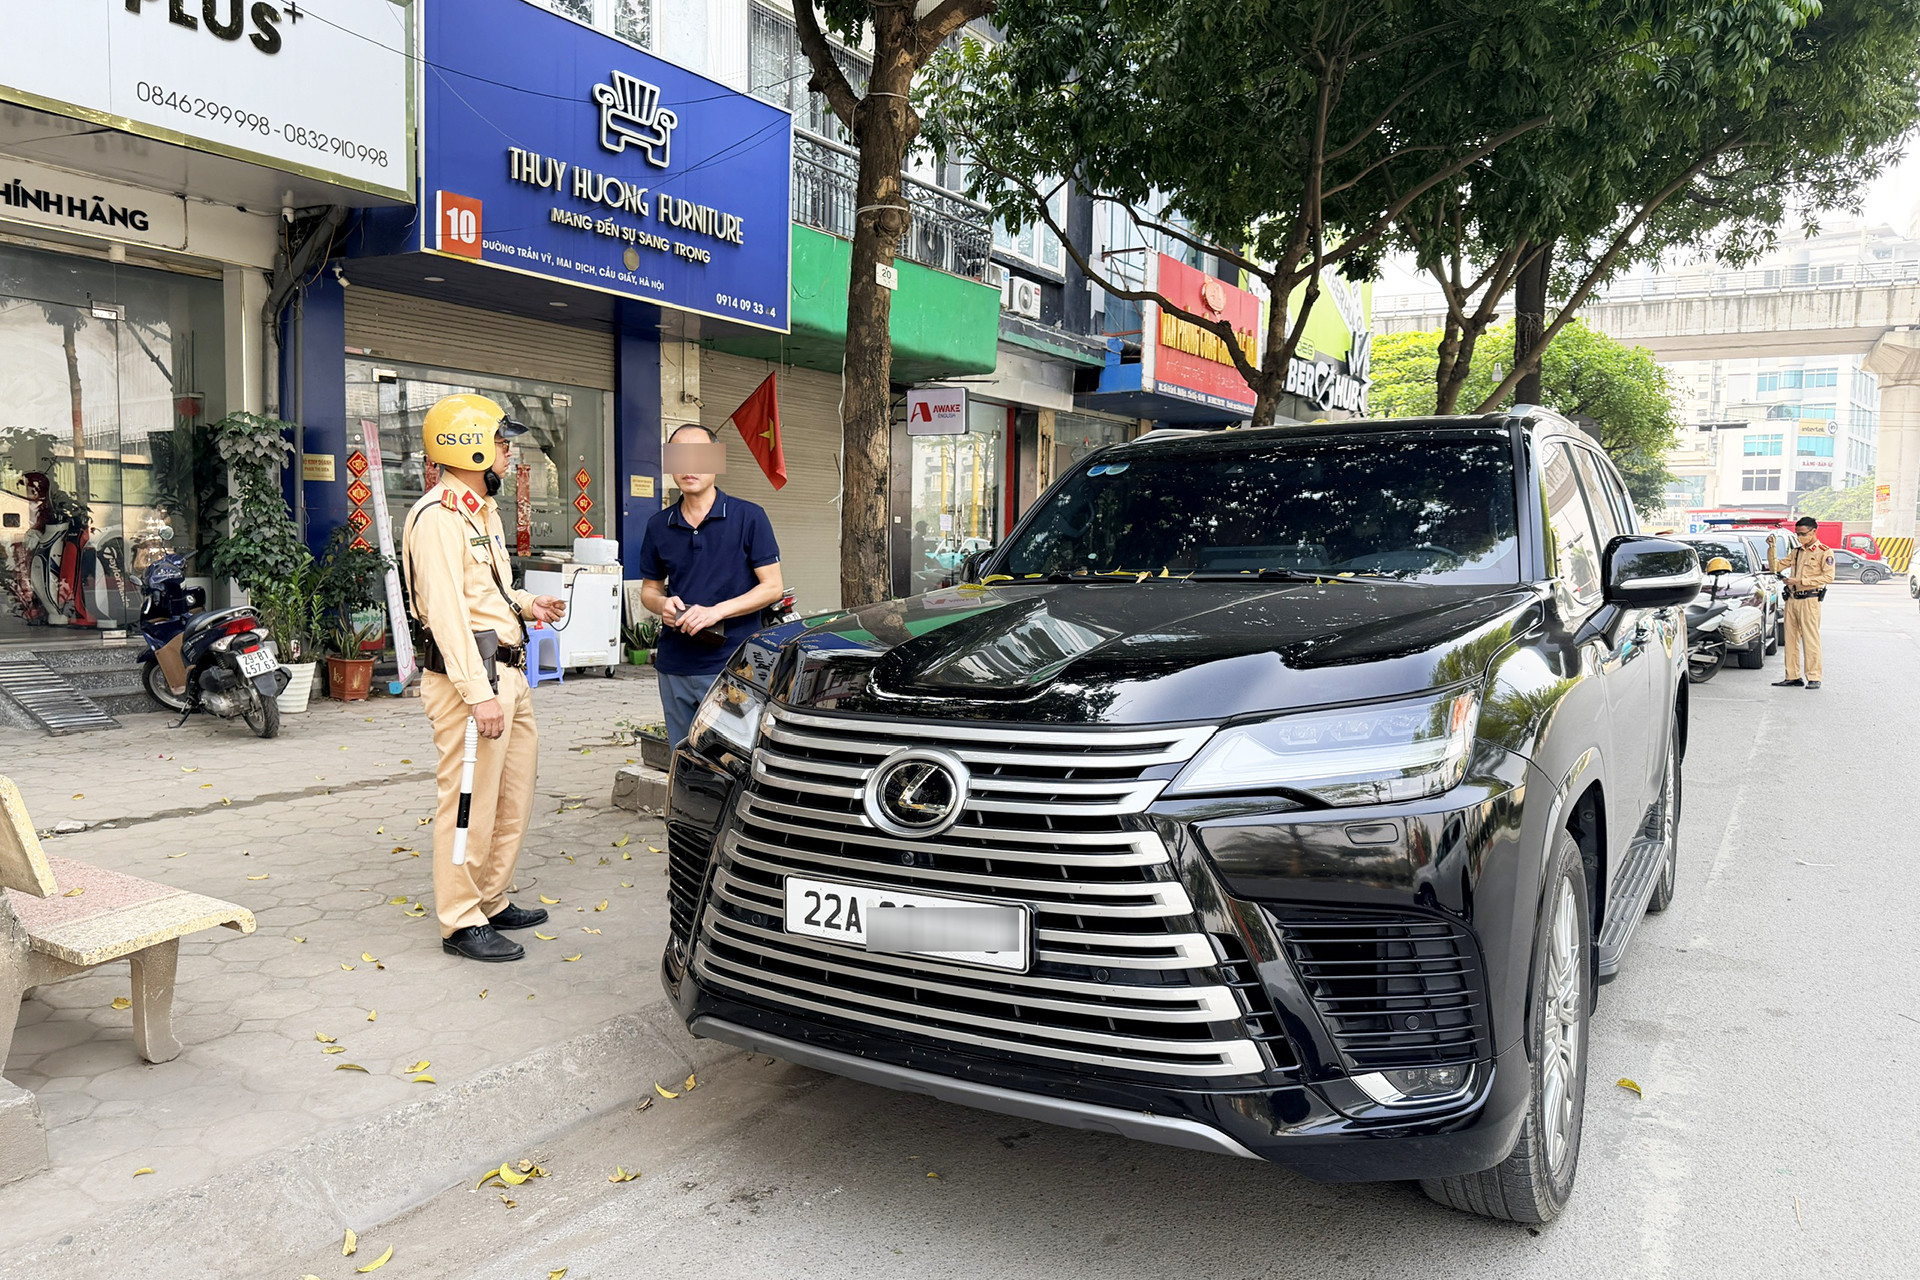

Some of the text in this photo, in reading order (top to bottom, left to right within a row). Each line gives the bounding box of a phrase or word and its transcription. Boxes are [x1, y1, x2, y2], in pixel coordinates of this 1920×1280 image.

[125, 0, 303, 54] LUS+
[137, 81, 270, 136] 0846299998
[284, 123, 389, 168] 0832910998
[67, 195, 149, 231] HÃNG
[508, 146, 744, 246] THUY HUONG FURNITURE
[446, 207, 476, 244] 10
[551, 207, 711, 264] MANG ĐẾN SỰ SANG TRỌNG
[482, 239, 515, 255] ĐƯỜNG
[517, 245, 539, 261] TRẦN
[556, 257, 572, 269] MAI
[575, 262, 597, 276] DỊCH,
[599, 265, 616, 279] CẦU
[639, 275, 650, 287] HÀ
[651, 279, 665, 292] NỘI
[881, 268, 892, 280] 20
[716, 293, 738, 309] 0914
[740, 299, 751, 312] 09
[753, 302, 764, 315] 33
[933, 404, 961, 413] AWAKE
